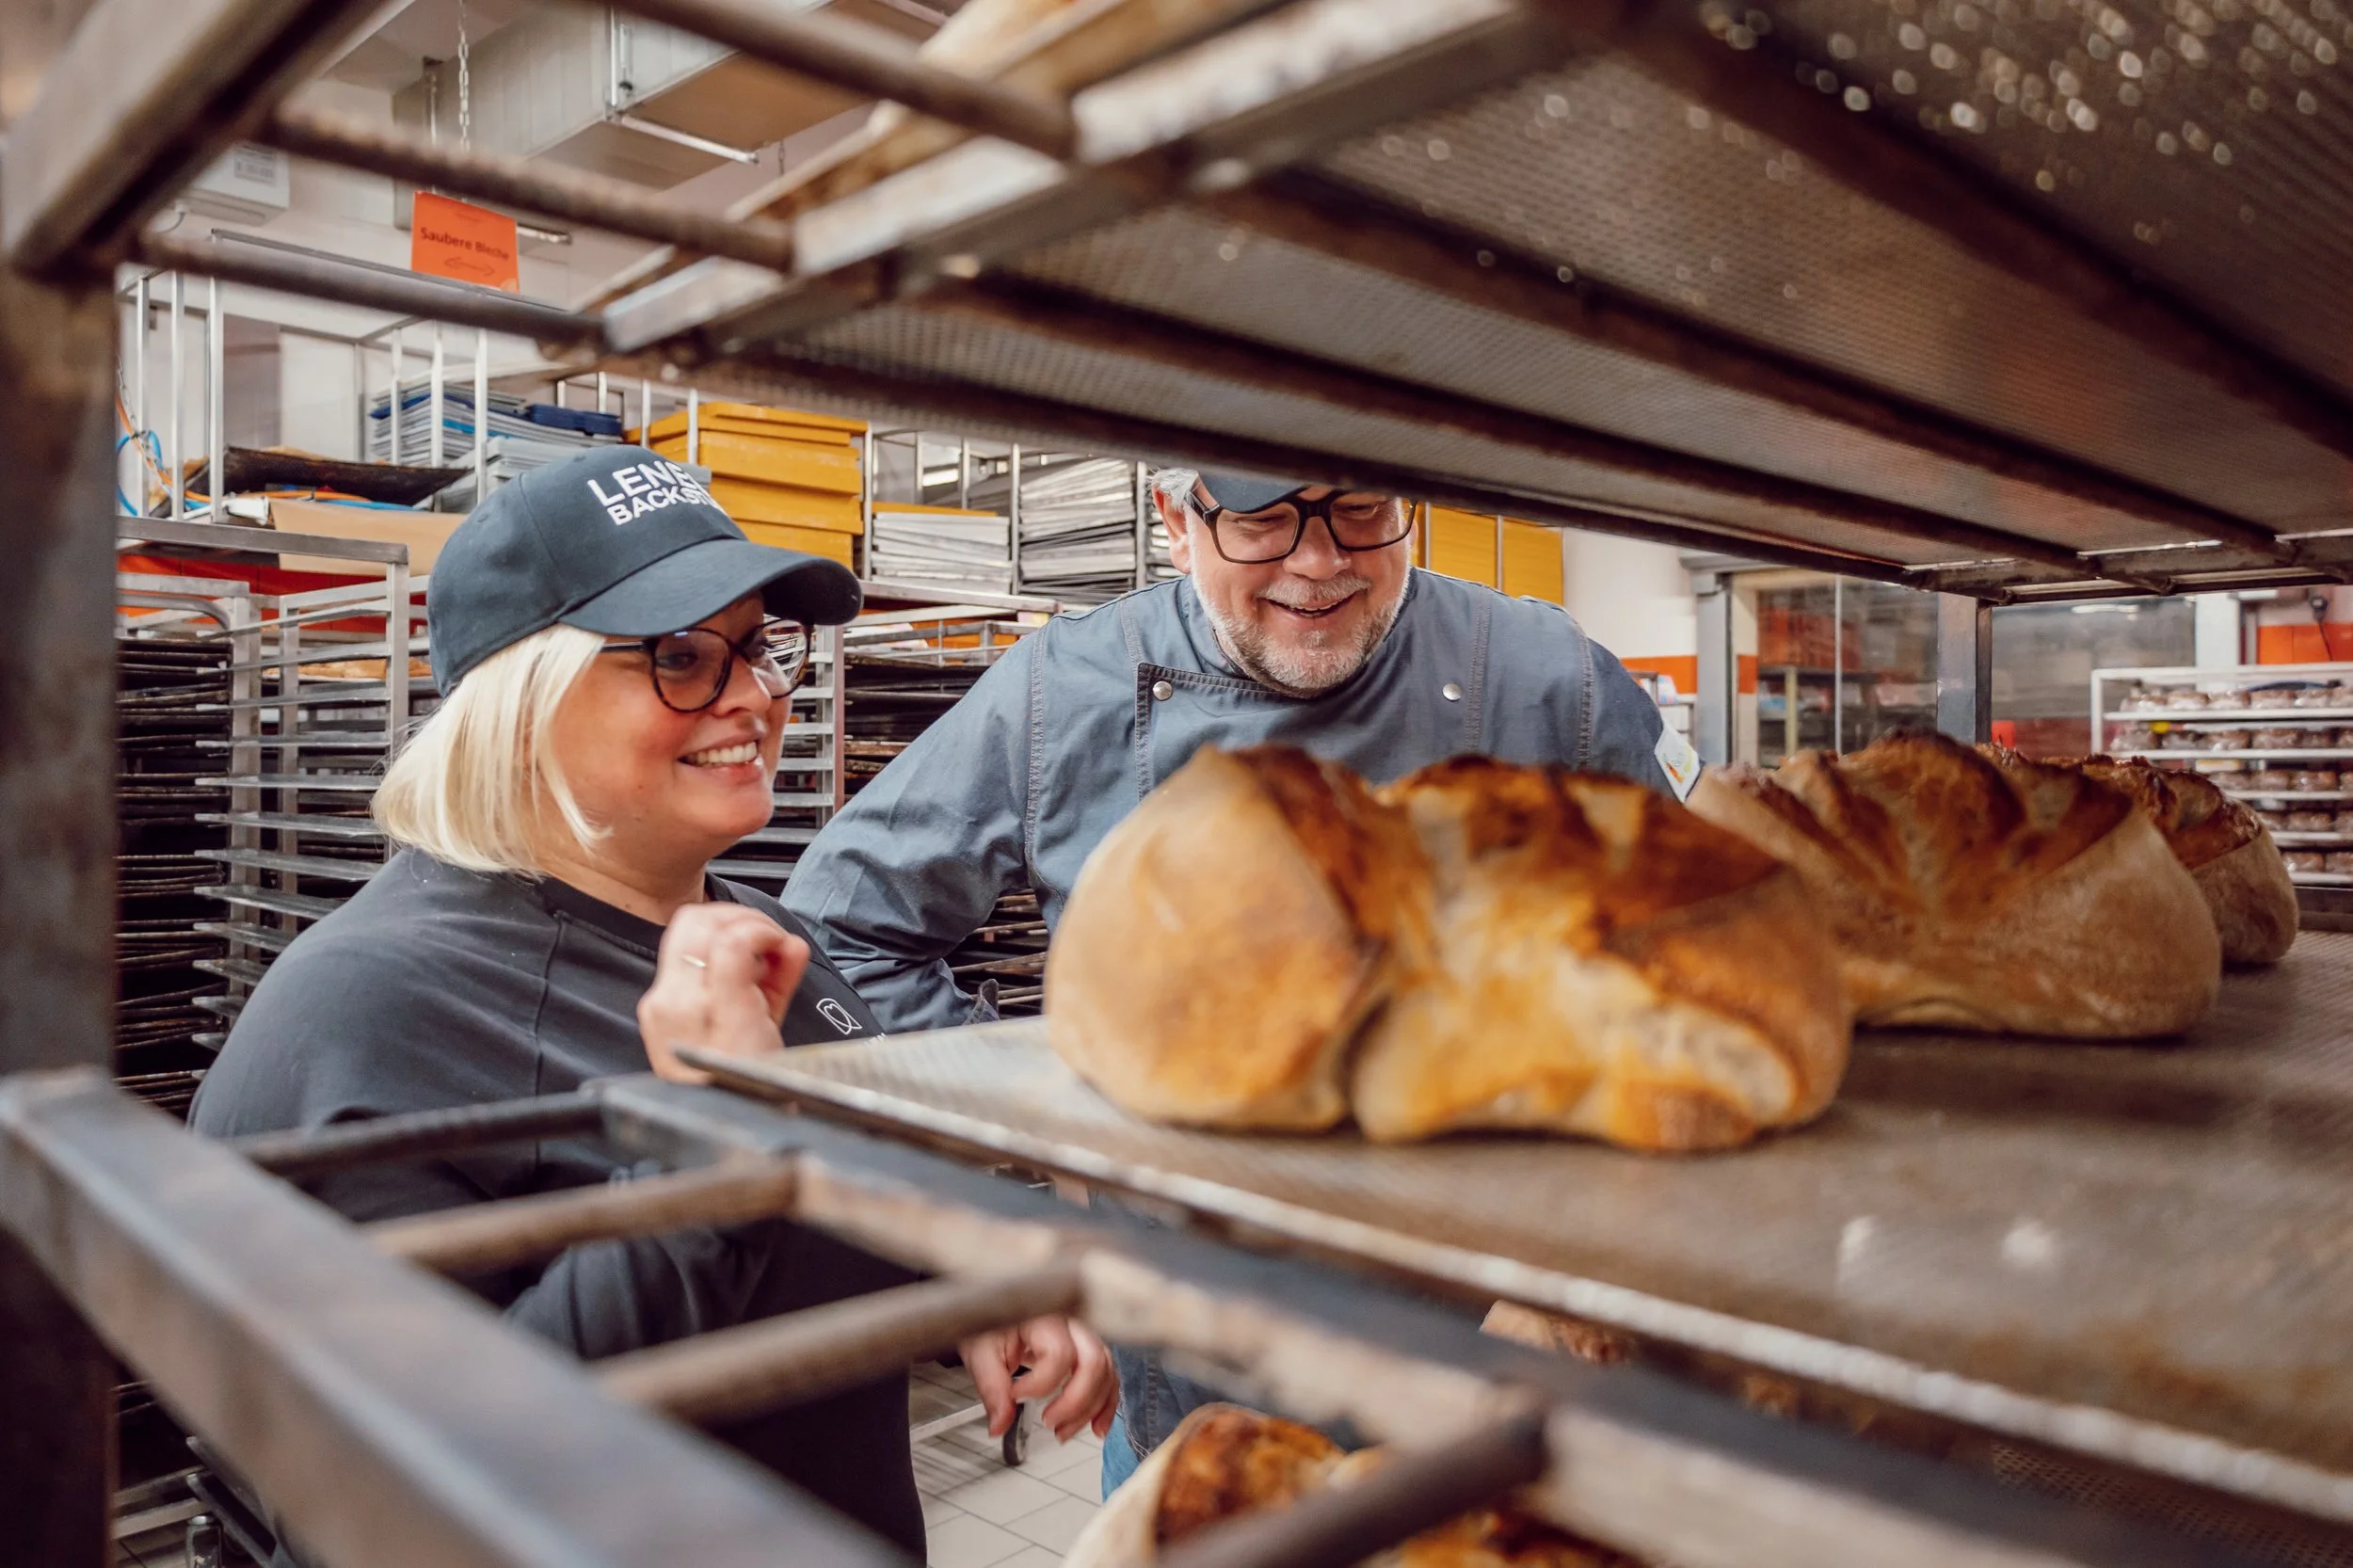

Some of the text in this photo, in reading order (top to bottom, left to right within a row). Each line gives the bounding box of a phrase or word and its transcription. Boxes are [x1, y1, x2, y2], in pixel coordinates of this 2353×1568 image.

[420, 226, 510, 261] Saubere Bleche
[587, 459, 704, 507] LENE
